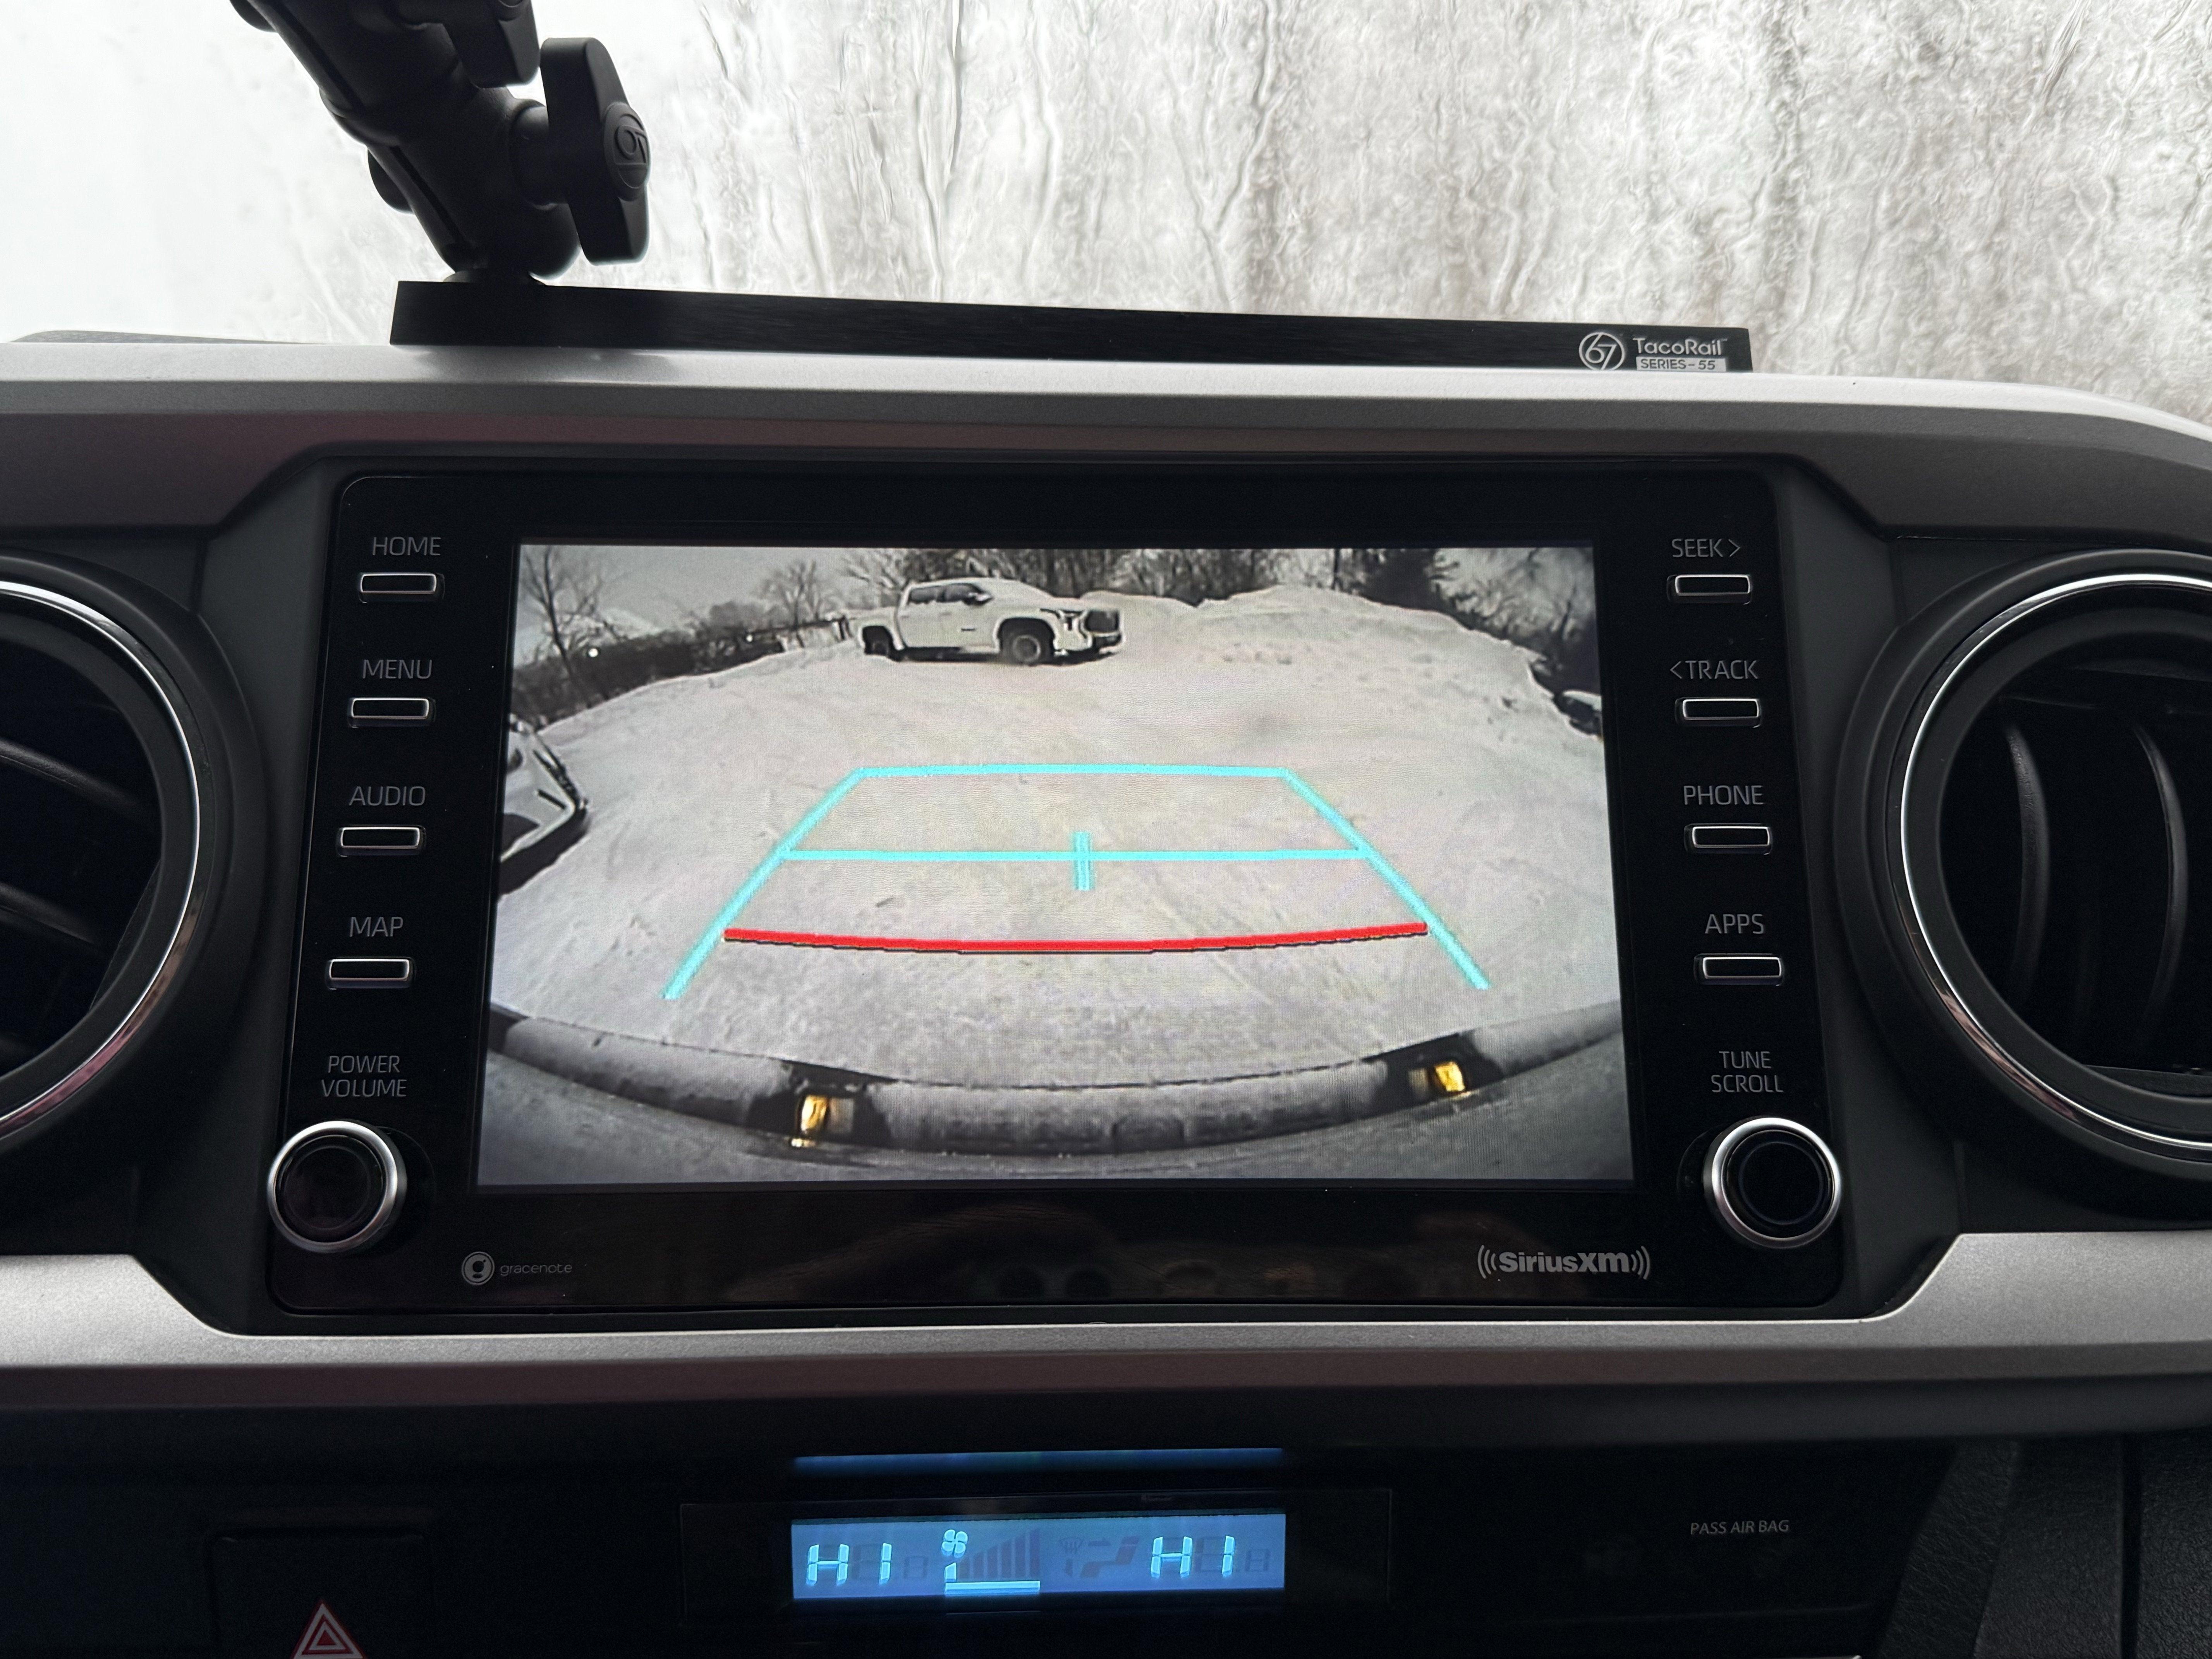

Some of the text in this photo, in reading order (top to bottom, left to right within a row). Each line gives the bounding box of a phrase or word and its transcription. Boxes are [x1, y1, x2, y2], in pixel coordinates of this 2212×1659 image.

[372, 536, 441, 556] HOME
[1671, 538, 1724, 558] SEEK
[362, 659, 433, 680] MENU
[1685, 659, 1759, 680] TRACK
[348, 785, 426, 806] AUDIO
[1683, 785, 1764, 805] PHONE
[349, 916, 404, 938] MAP
[1704, 913, 1764, 934] APPS
[328, 1055, 400, 1073] POWER
[1718, 1051, 1772, 1069] TUNE
[321, 1079, 407, 1098] VOLUME
[1711, 1074, 1784, 1093] SCROLL
[500, 1263, 573, 1276] gracenote
[1690, 1519, 1790, 1535] PASS AIR BAG
